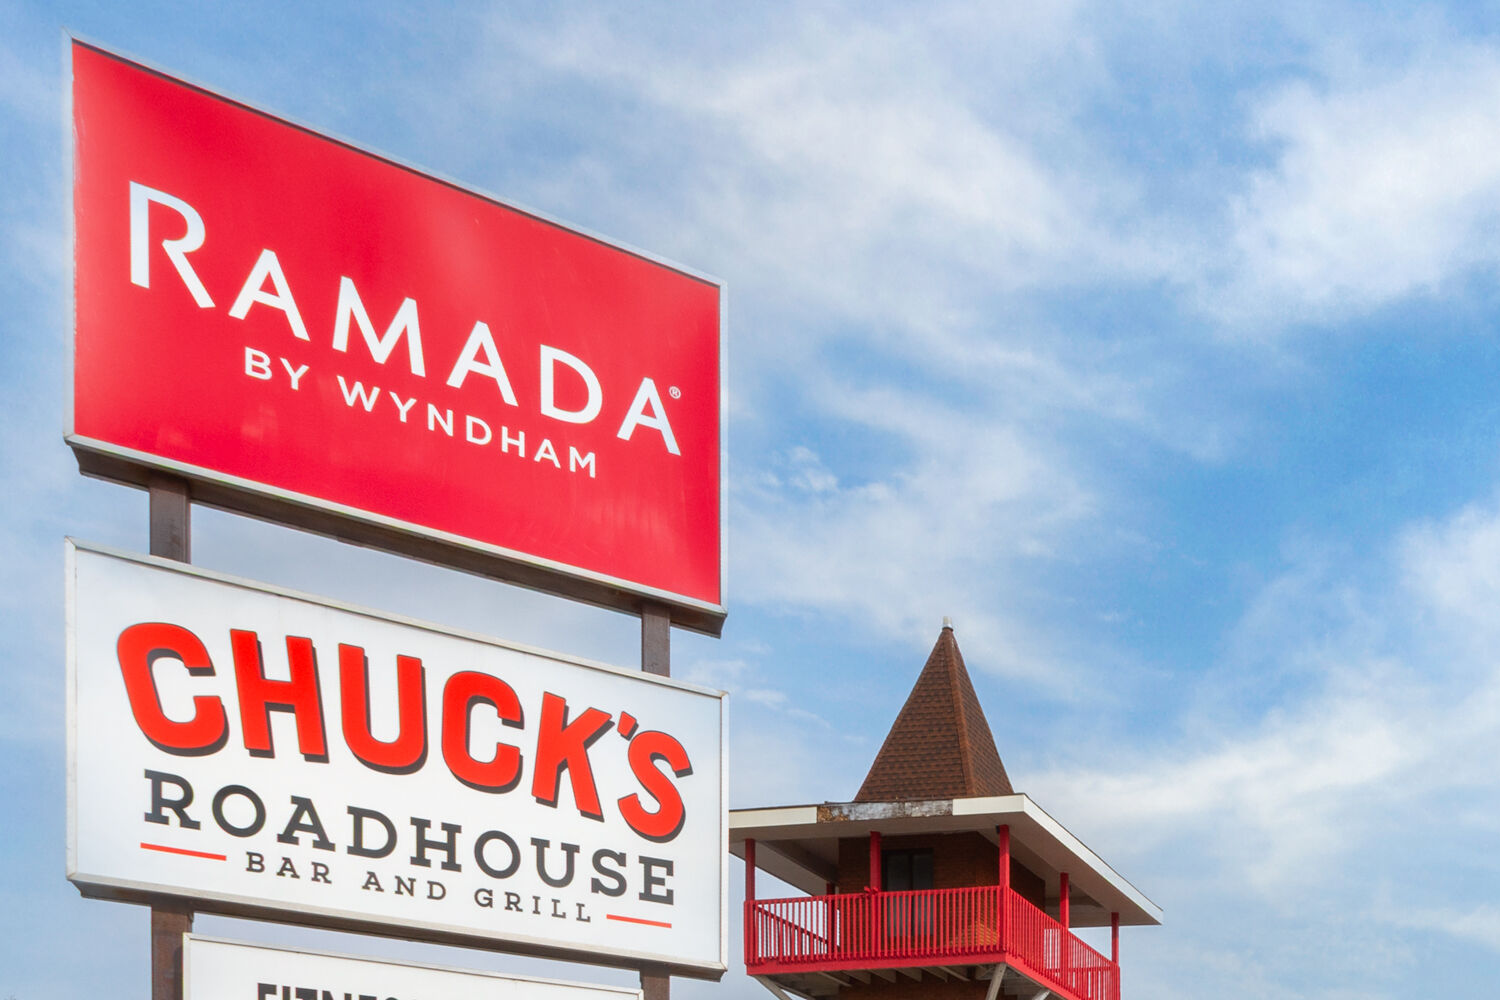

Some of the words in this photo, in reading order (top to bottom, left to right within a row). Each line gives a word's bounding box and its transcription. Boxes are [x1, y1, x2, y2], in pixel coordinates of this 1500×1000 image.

[244, 346, 310, 391] BY
[336, 376, 597, 479] WYNDHAM
[117, 622, 694, 843] CHUCK'S
[144, 769, 675, 906] ROADHOUSE
[245, 851, 332, 884] BAR
[365, 871, 447, 901] AND
[474, 888, 592, 923] GRILL
